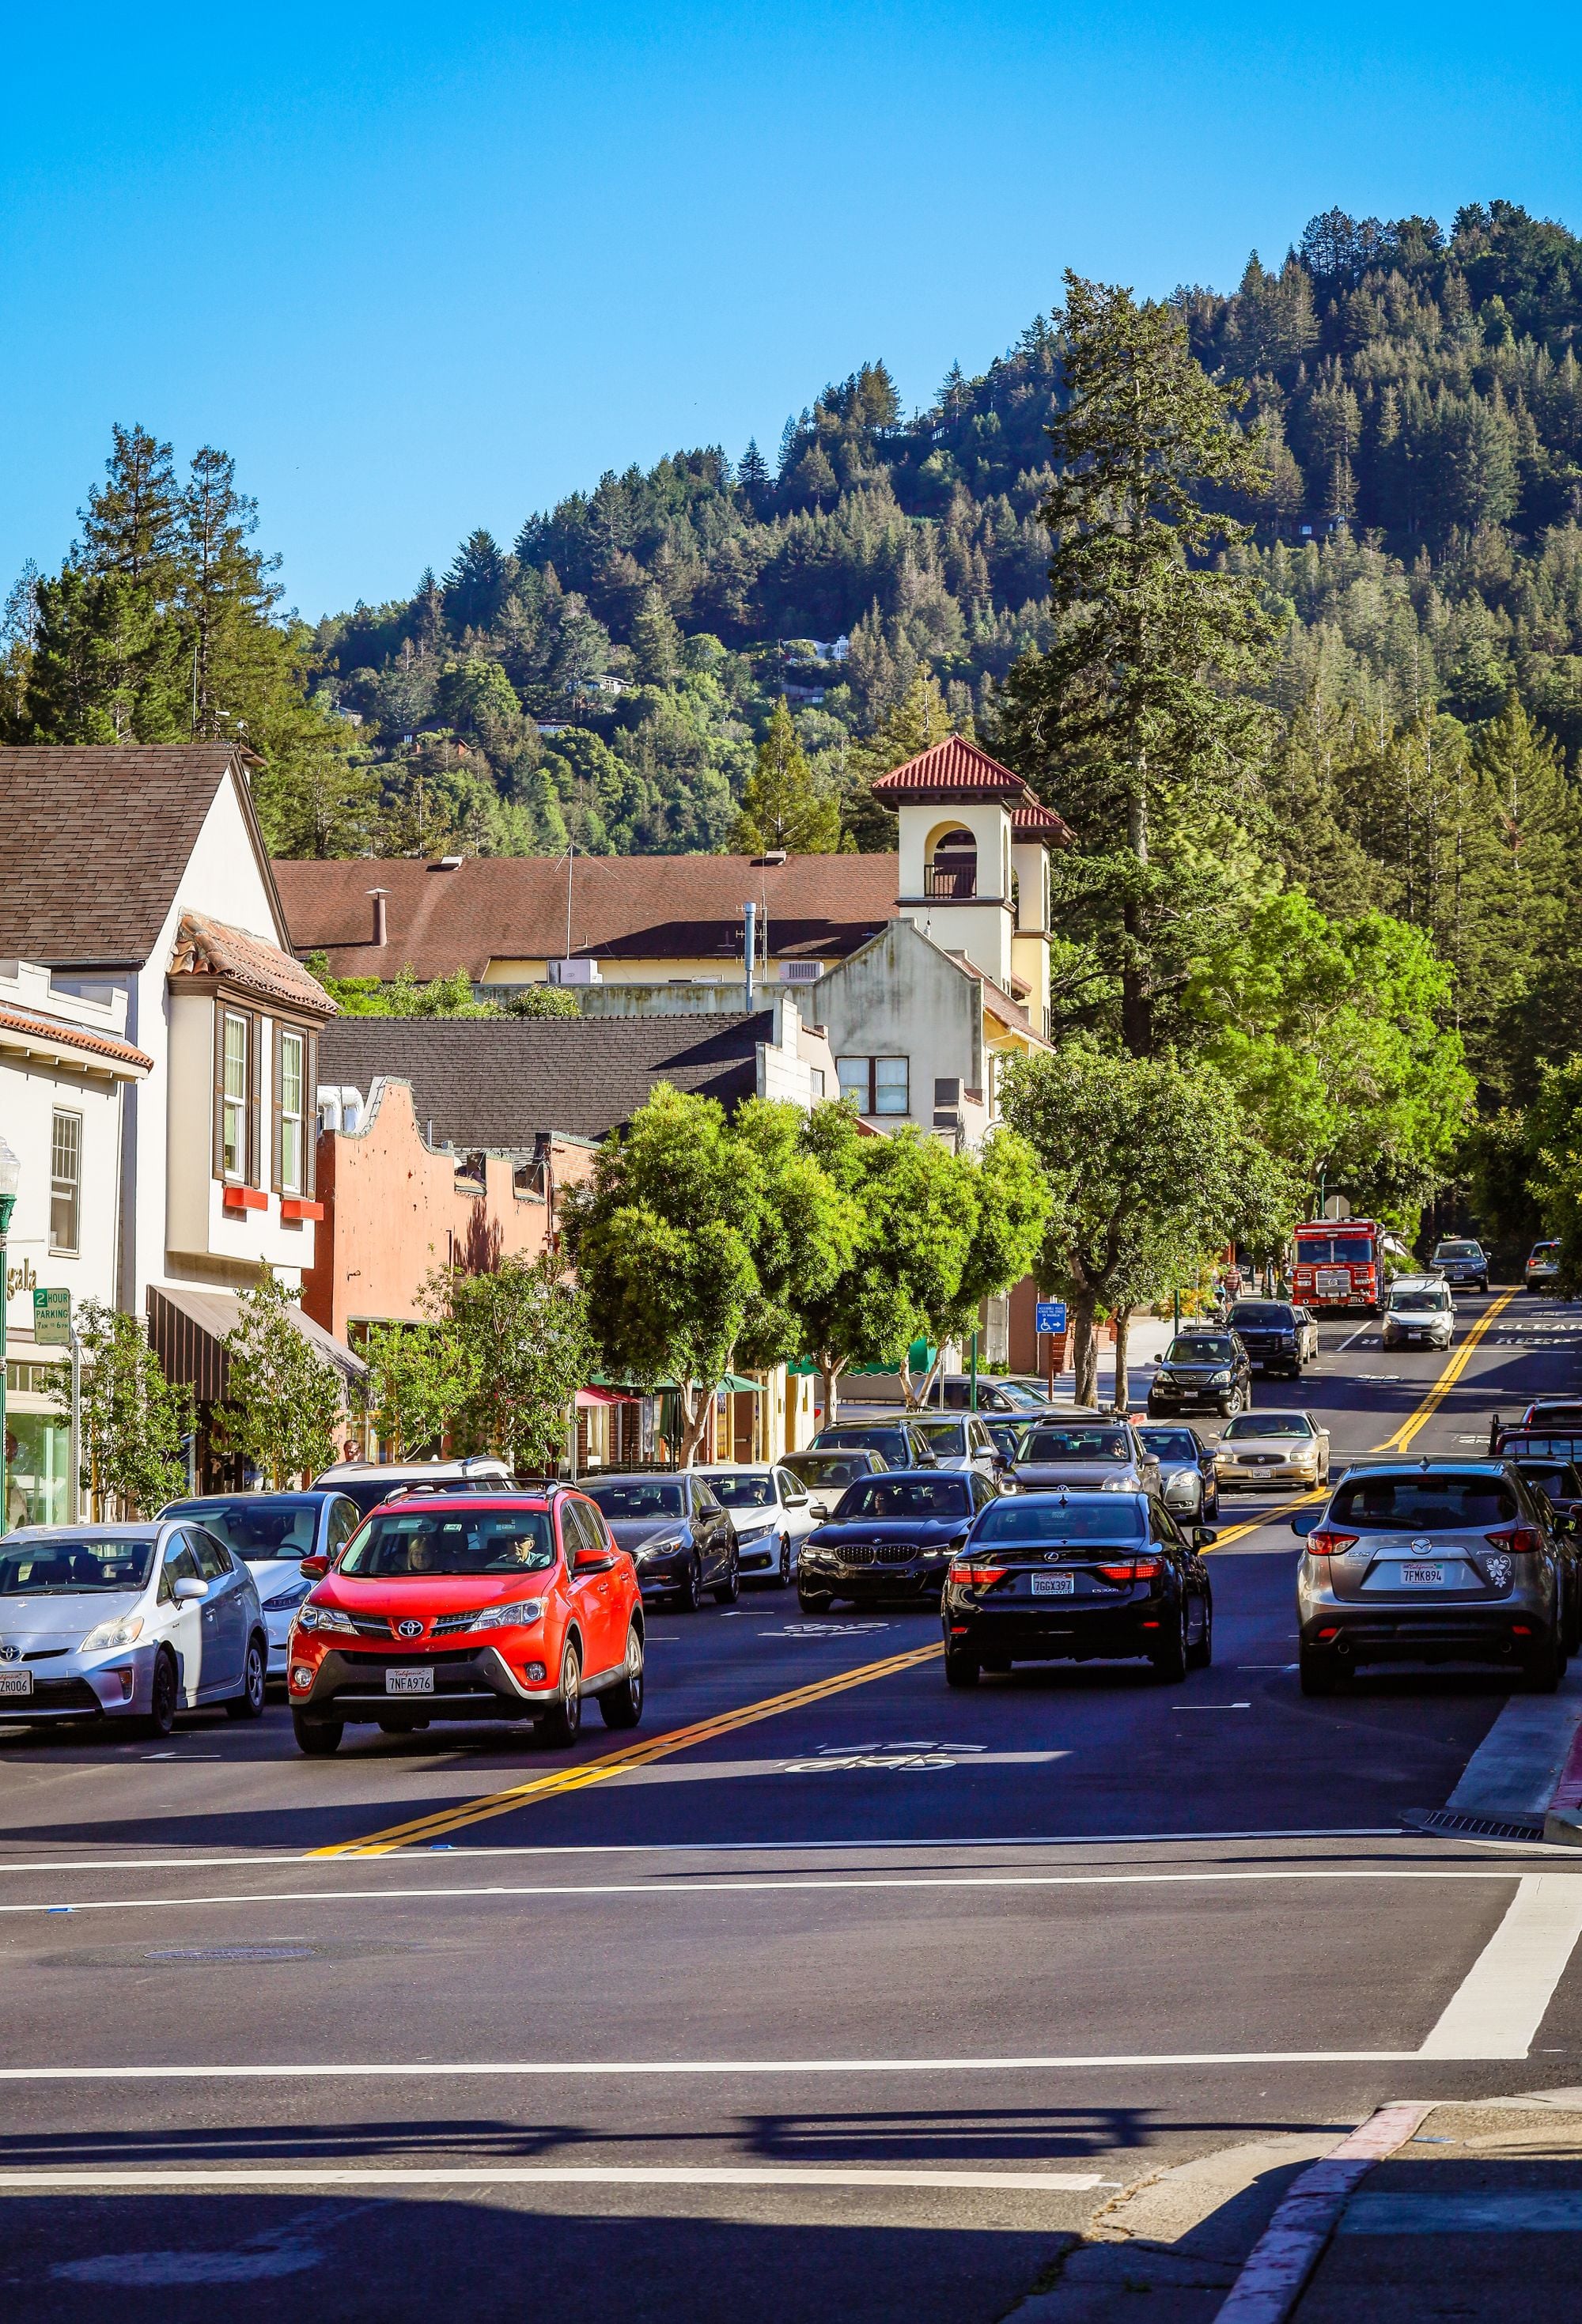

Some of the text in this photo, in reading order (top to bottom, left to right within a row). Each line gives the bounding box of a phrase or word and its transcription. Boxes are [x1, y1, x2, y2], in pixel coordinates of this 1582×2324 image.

[7, 1258, 36, 1301] gala
[36, 1293, 68, 1305] 2 HOUR
[36, 1310, 68, 1319] PARKING
[1403, 1570, 1442, 1581] 7FMK894
[1035, 1580, 1071, 1591] 7GGX397
[0, 1679, 27, 1691] ZR006
[388, 1677, 430, 1690] 7NFA976
